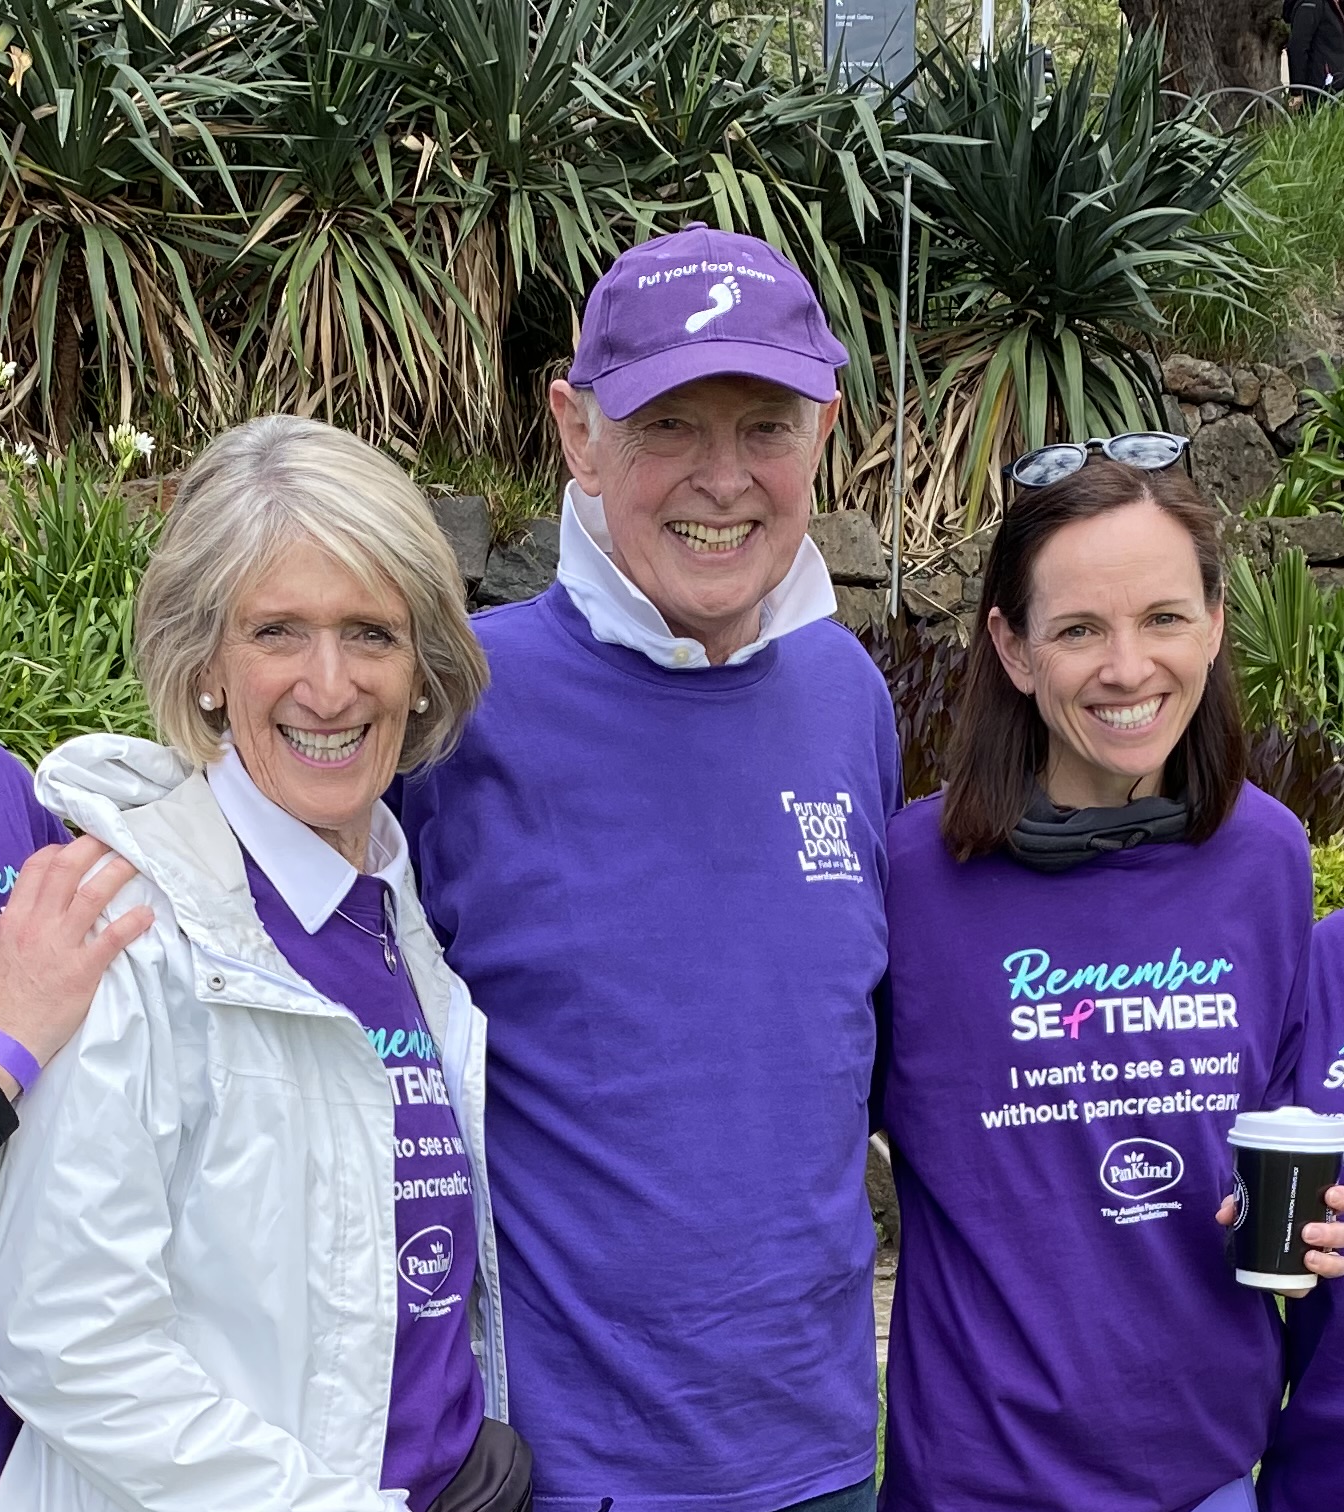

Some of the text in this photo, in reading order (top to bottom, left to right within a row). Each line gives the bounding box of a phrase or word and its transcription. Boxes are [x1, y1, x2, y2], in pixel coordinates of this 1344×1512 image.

[638, 260, 776, 289] Put your foot down
[793, 802, 845, 817] PUT YOUR
[798, 815, 847, 839] FOOT
[804, 839, 852, 858] DOWN
[1002, 946, 1233, 1001] Remember
[1010, 993, 1240, 1041] SEPTEMBER
[1010, 1051, 1240, 1089] I want to see a world
[981, 1101, 1078, 1129] without
[1083, 1089, 1204, 1123] pancreatic
[418, 1136, 443, 1157] see
[442, 1136, 454, 1156] a
[1109, 1160, 1173, 1184] PanKind
